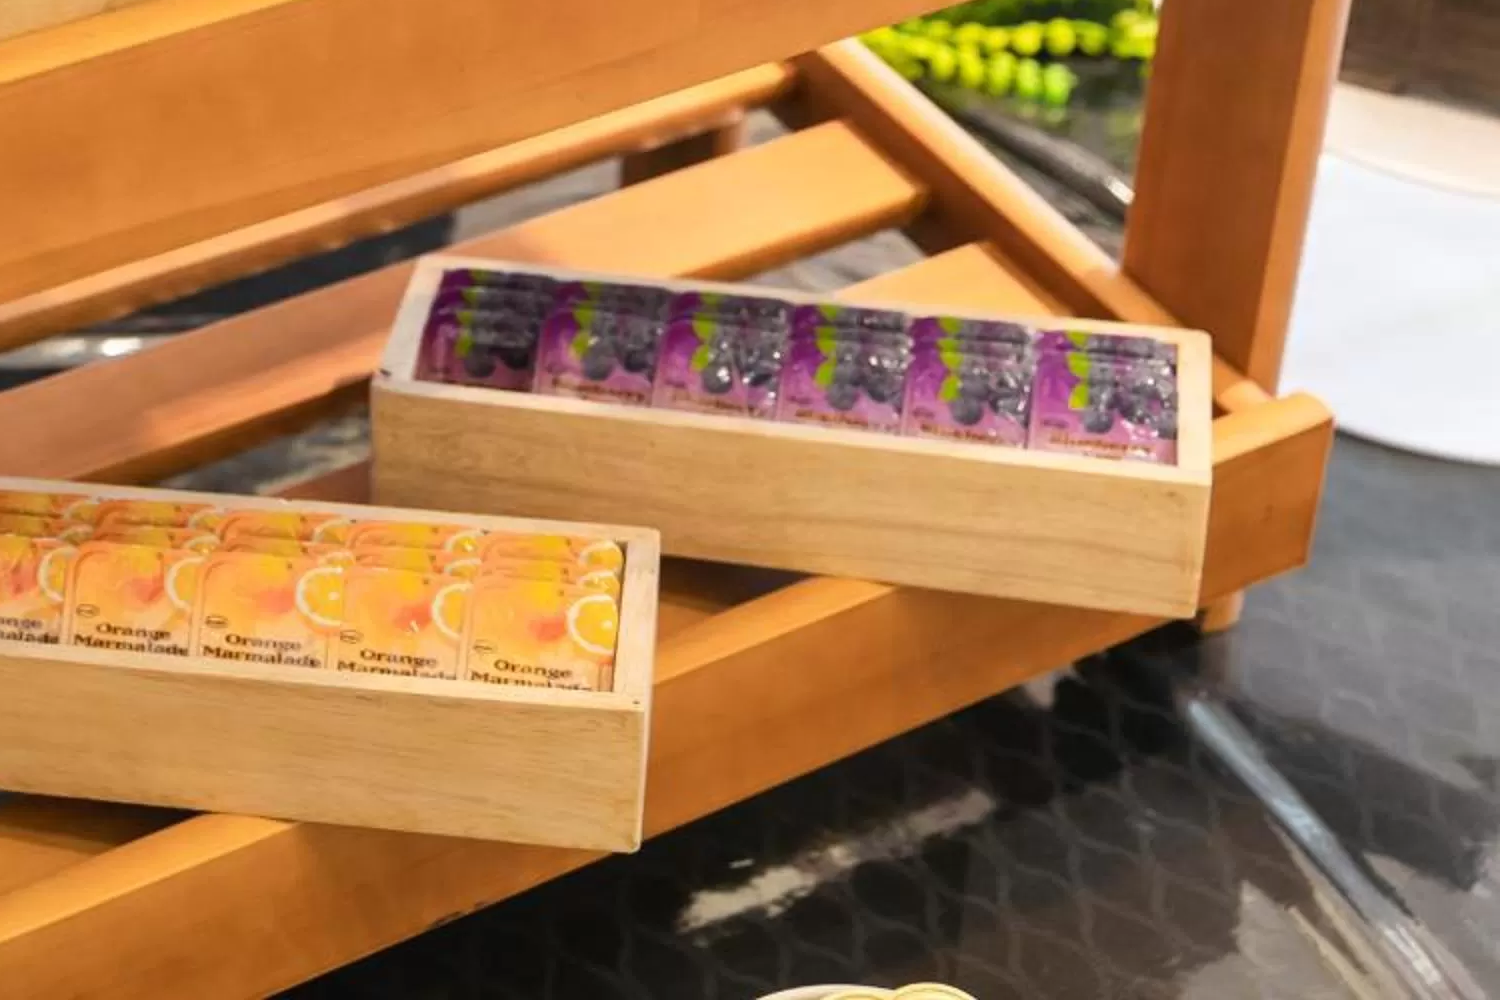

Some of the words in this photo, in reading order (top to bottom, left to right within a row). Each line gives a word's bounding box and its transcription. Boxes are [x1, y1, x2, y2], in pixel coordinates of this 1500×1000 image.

[95, 623, 173, 641] Orange
[225, 633, 302, 651] Orange
[74, 633, 190, 657] Marmalade
[202, 644, 322, 669] Marmalade
[360, 648, 438, 669] Orange
[493, 659, 573, 680] Orange
